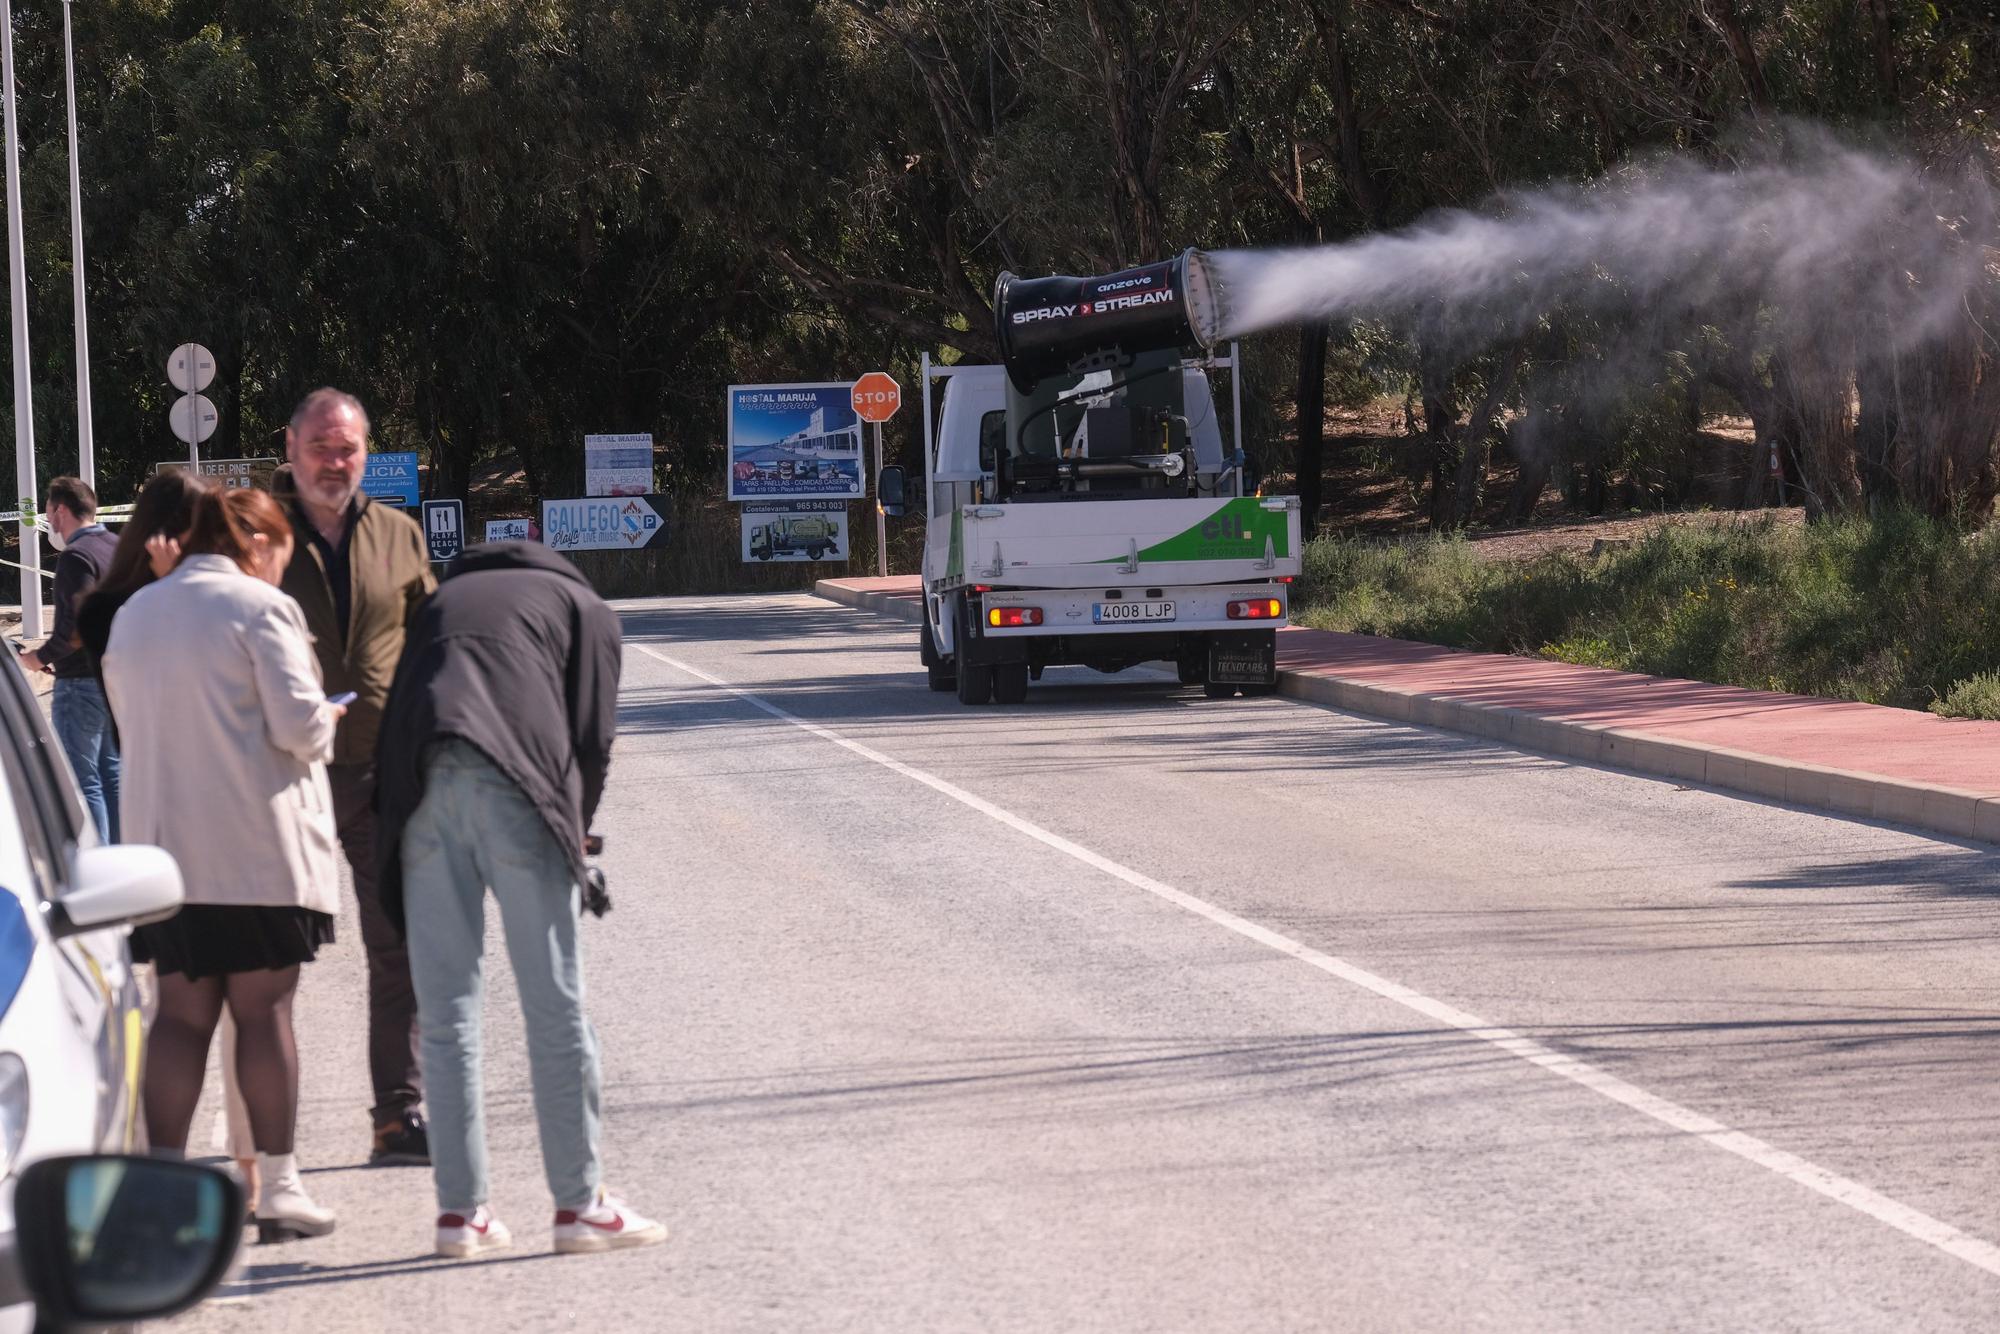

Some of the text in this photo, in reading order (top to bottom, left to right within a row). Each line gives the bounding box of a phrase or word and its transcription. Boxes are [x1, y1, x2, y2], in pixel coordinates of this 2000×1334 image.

[1097, 276, 1152, 293] anzeve
[1013, 289, 1174, 324] SPRAY STREAM
[738, 393, 817, 403] HOSTAL MARUJA
[854, 391, 897, 405] STOP
[206, 464, 218, 476] DE
[218, 463, 228, 475] EL
[229, 462, 252, 475] PINET
[741, 480, 760, 488] TAPAS
[794, 478, 823, 486] COMIDAS
[796, 501, 844, 511] 965 943 003
[547, 504, 621, 534] GALLEGO
[550, 529, 581, 548] Playa
[582, 531, 621, 543] LIVE MUSIC
[1102, 603, 1140, 619] 4008
[1145, 603, 1172, 618] LJP
